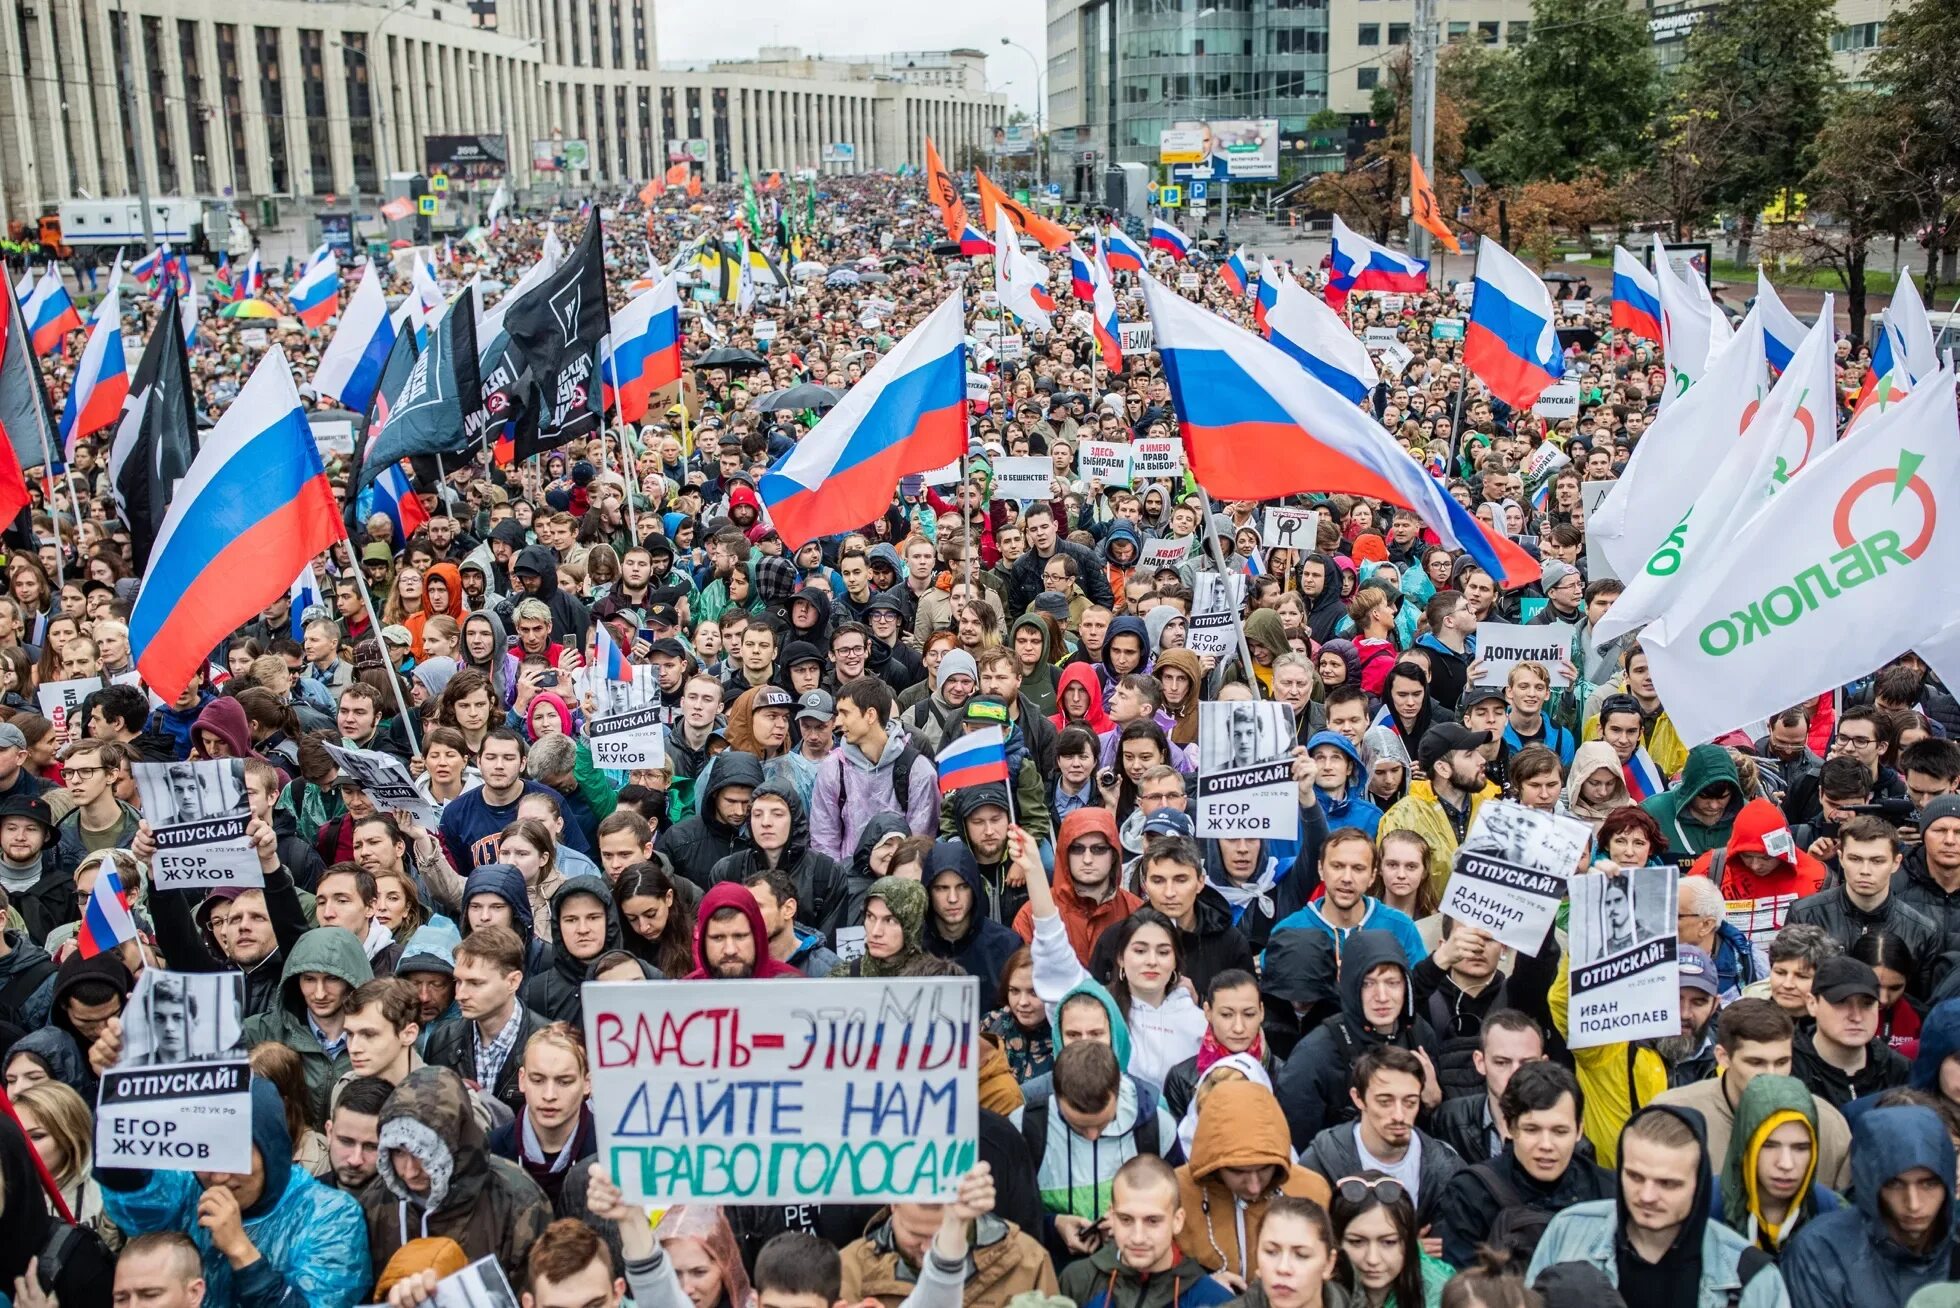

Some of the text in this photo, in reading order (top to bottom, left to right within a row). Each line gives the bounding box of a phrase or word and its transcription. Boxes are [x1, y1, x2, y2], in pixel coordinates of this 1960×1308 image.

[1194, 183, 1203, 197] P
[1091, 447, 1114, 457] ЗДЕСЬ
[1147, 443, 1171, 452] ИМЕЮ
[1082, 456, 1124, 468] ВЫБИРАЕМ
[1142, 453, 1168, 461] ПРАВО
[1092, 467, 1109, 477] МЫ!
[1147, 461, 1177, 470] ВЫБОР!
[1009, 474, 1049, 482] БЕШЕНСТВЕ!
[1143, 557, 1165, 566] НАМ
[1193, 633, 1219, 643] ЕГОР
[1191, 642, 1227, 653] ЖУКОВ
[1484, 644, 1563, 661] ДОПУСКАЙ!
[596, 711, 655, 733] ОТПУСКАЙ!
[597, 743, 628, 752] ЕГОР
[599, 753, 645, 763] ЖУКОВ
[1208, 765, 1290, 791] ОТПУСКАЙ!
[1208, 803, 1250, 815] ЕГОР
[1207, 817, 1271, 830] ЖУКОВ
[156, 820, 244, 845] ОТПУСКАЙ!
[161, 857, 207, 868] ЕГОР
[163, 869, 235, 882] ЖУКОВ
[1465, 859, 1558, 894] ОТПУСКАЙ!
[1455, 885, 1524, 923] ДАНИИЛ
[1451, 897, 1506, 931] КОНОН
[1580, 942, 1666, 988] ОТПУСКАЙ!
[1580, 1000, 1618, 1018] ИВАН
[789, 1007, 864, 1070] ЭТО
[865, 985, 973, 1071] МЫ
[1580, 1009, 1669, 1034] ПОДКОПАЕВ
[116, 1066, 239, 1098] ОТПУСКАЙ!
[193, 1105, 206, 1113] 212
[223, 1107, 236, 1115] РФ
[611, 1077, 958, 1137] ДАЙТЕ НАМ
[114, 1117, 177, 1137] ЕГОР
[112, 1138, 210, 1159] ЖУКОВ
[610, 1142, 761, 1197] ПРАВО
